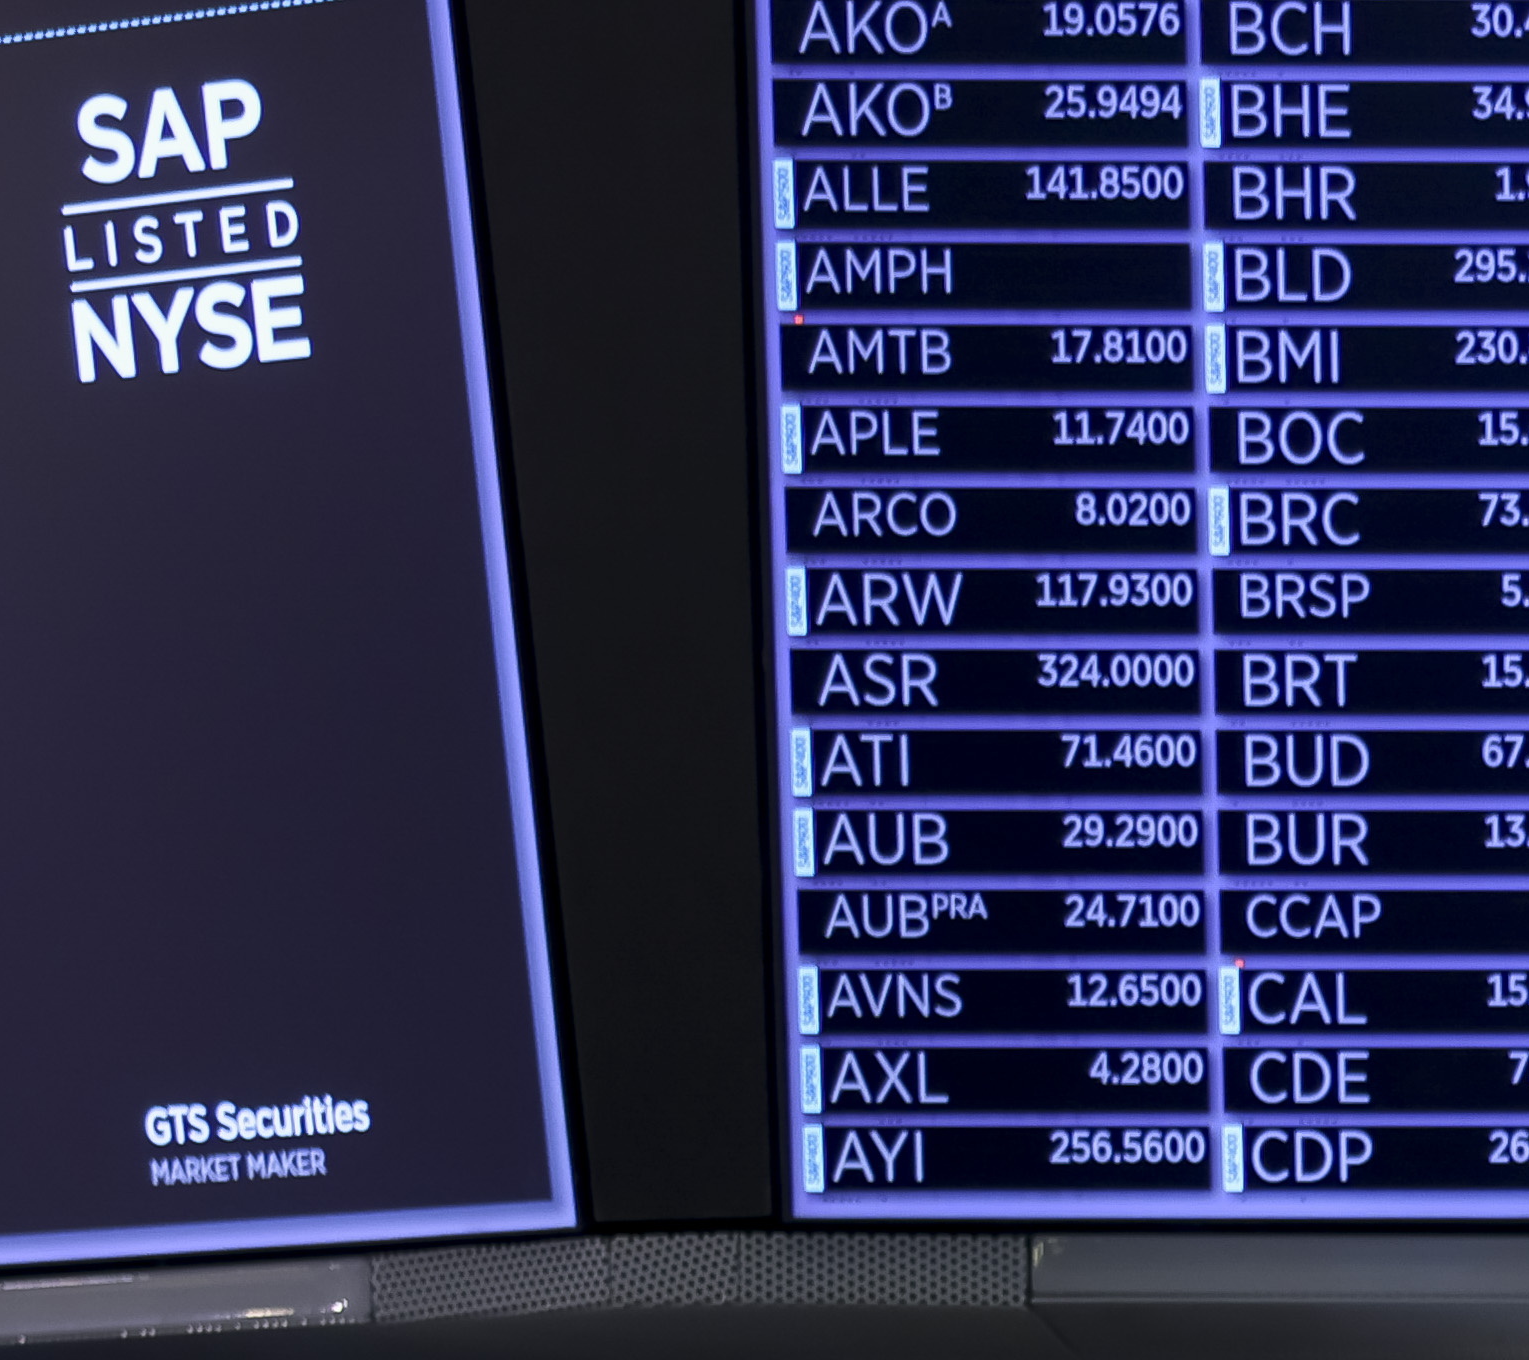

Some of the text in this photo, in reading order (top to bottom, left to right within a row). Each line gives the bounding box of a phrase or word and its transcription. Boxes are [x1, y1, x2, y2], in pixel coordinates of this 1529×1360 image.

[1228, 0, 1352, 56] BCH
[77, 79, 262, 184] SAP
[1231, 164, 1357, 221] BHR
[63, 200, 299, 273] LISTED
[805, 247, 953, 294] AMPH
[71, 274, 312, 383] NYSE
[810, 409, 1190, 456] APLE 11.7400
[1237, 409, 1366, 466] BOC
[1239, 571, 1371, 619] BRSP
[817, 652, 1196, 707] ASR 324.0000
[823, 811, 1200, 866] AUB 29.2900
[1245, 811, 1369, 866] BUR
[1247, 971, 1368, 1025] CAL
[830, 1049, 1205, 1104] AXL 4.2800
[144, 1094, 371, 1146] GTS Securities
[150, 1147, 327, 1187] MARKET MAKER
